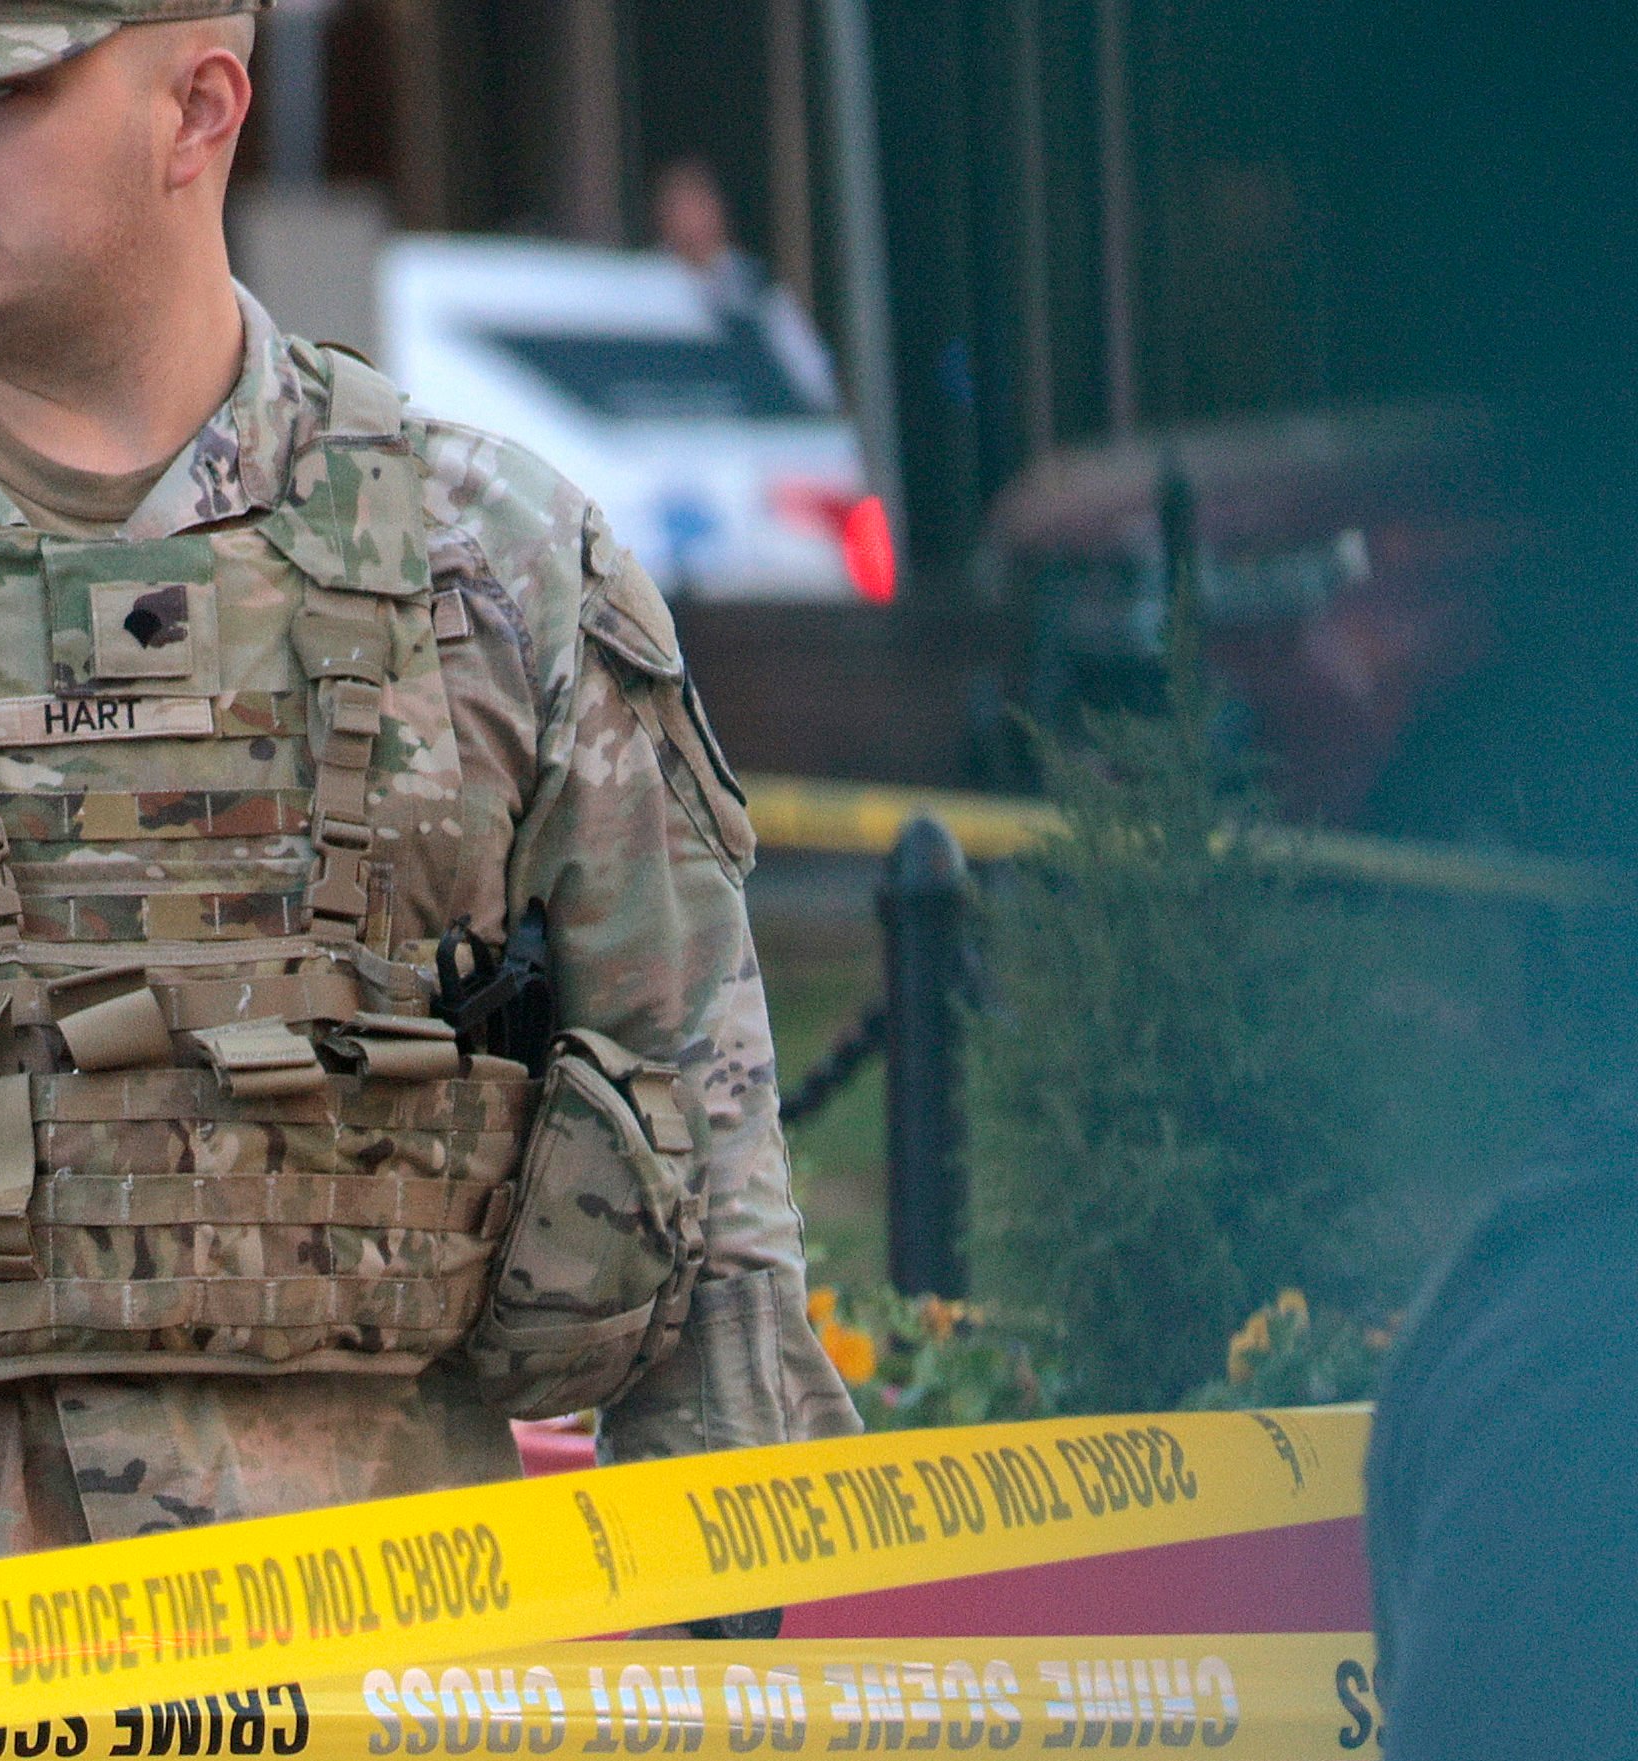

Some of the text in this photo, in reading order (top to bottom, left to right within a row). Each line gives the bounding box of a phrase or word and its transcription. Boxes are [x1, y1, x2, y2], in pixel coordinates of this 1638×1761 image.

[44, 698, 142, 734] HART
[109, 1682, 311, 1757] CRIME
[362, 1665, 566, 1756] CROSS
[581, 1664, 706, 1754] NOT
[721, 1663, 808, 1754] DO
[824, 1660, 1023, 1753] SCENE
[1038, 1656, 1242, 1750] CRIME
